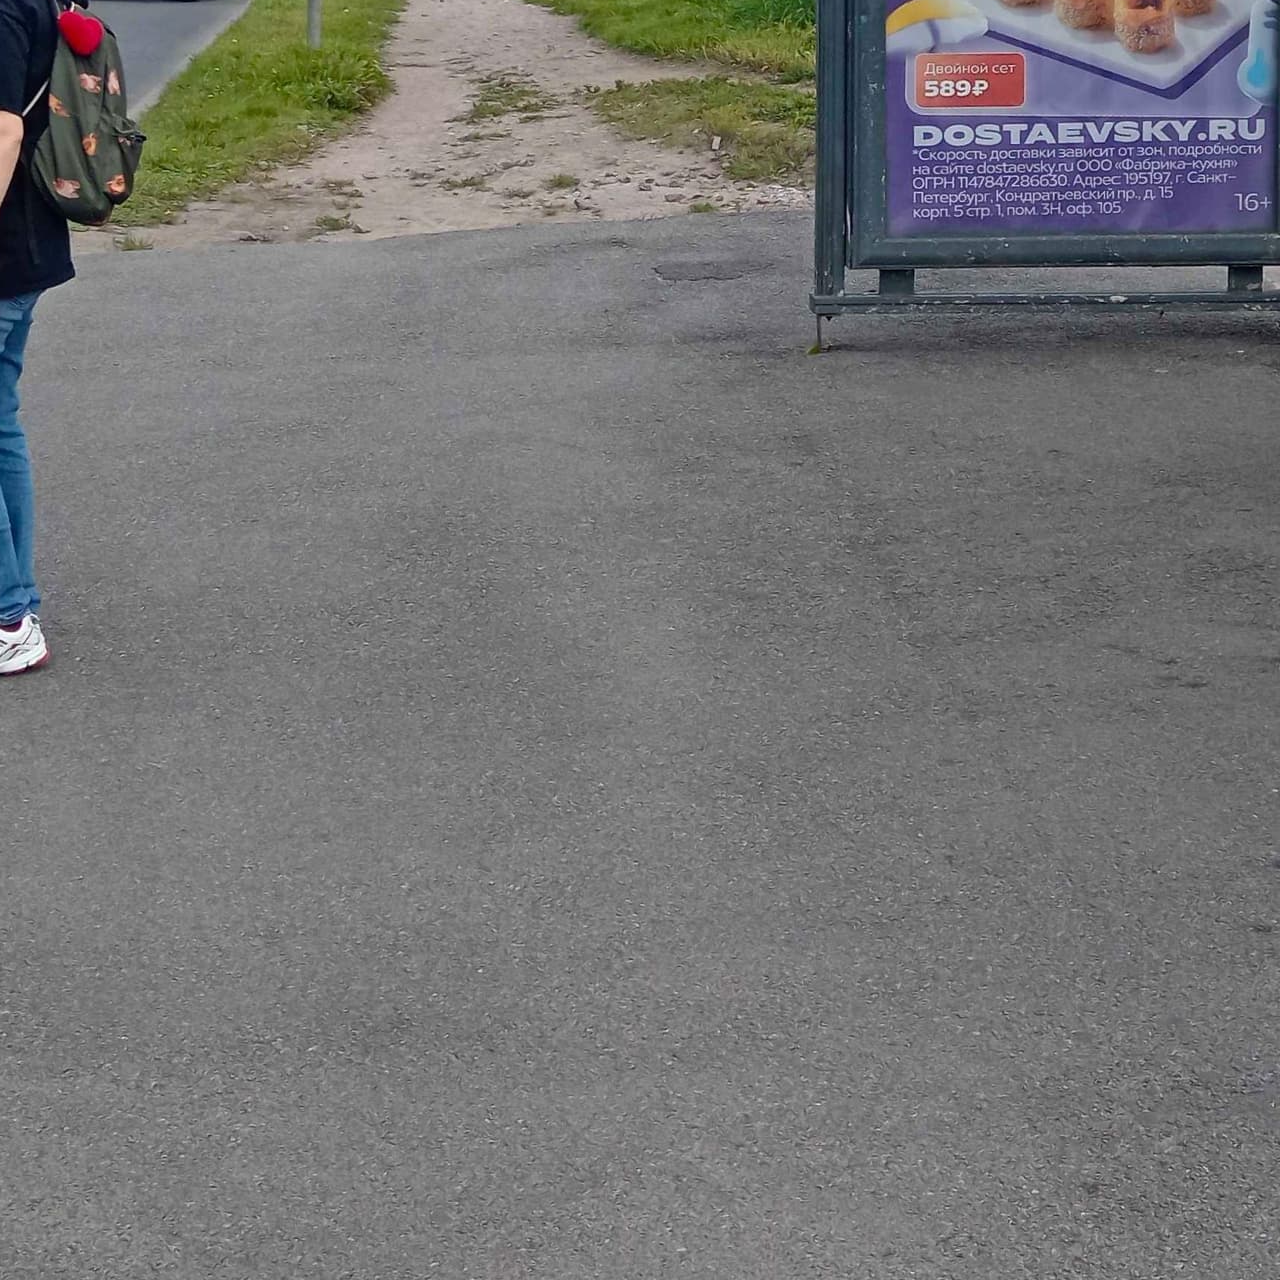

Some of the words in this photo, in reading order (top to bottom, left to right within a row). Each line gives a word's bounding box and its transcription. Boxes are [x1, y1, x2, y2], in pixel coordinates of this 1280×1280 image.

[923, 63, 989, 77] Двойной
[992, 64, 1017, 74] сет
[913, 118, 1266, 148] DOSTAEVSKY.RU
[989, 147, 1056, 162] доставки
[1058, 147, 1115, 159] зависит
[1118, 147, 1135, 157] от
[1168, 142, 1263, 159] подробности
[912, 165, 931, 176] на
[932, 162, 974, 175] сайте
[976, 160, 1074, 177] dostaevsky.ru
[912, 176, 955, 190] ОГРН
[995, 187, 1116, 204] Кондратьевский
[1234, 192, 1273, 212] 16+
[953, 205, 964, 218] 5
